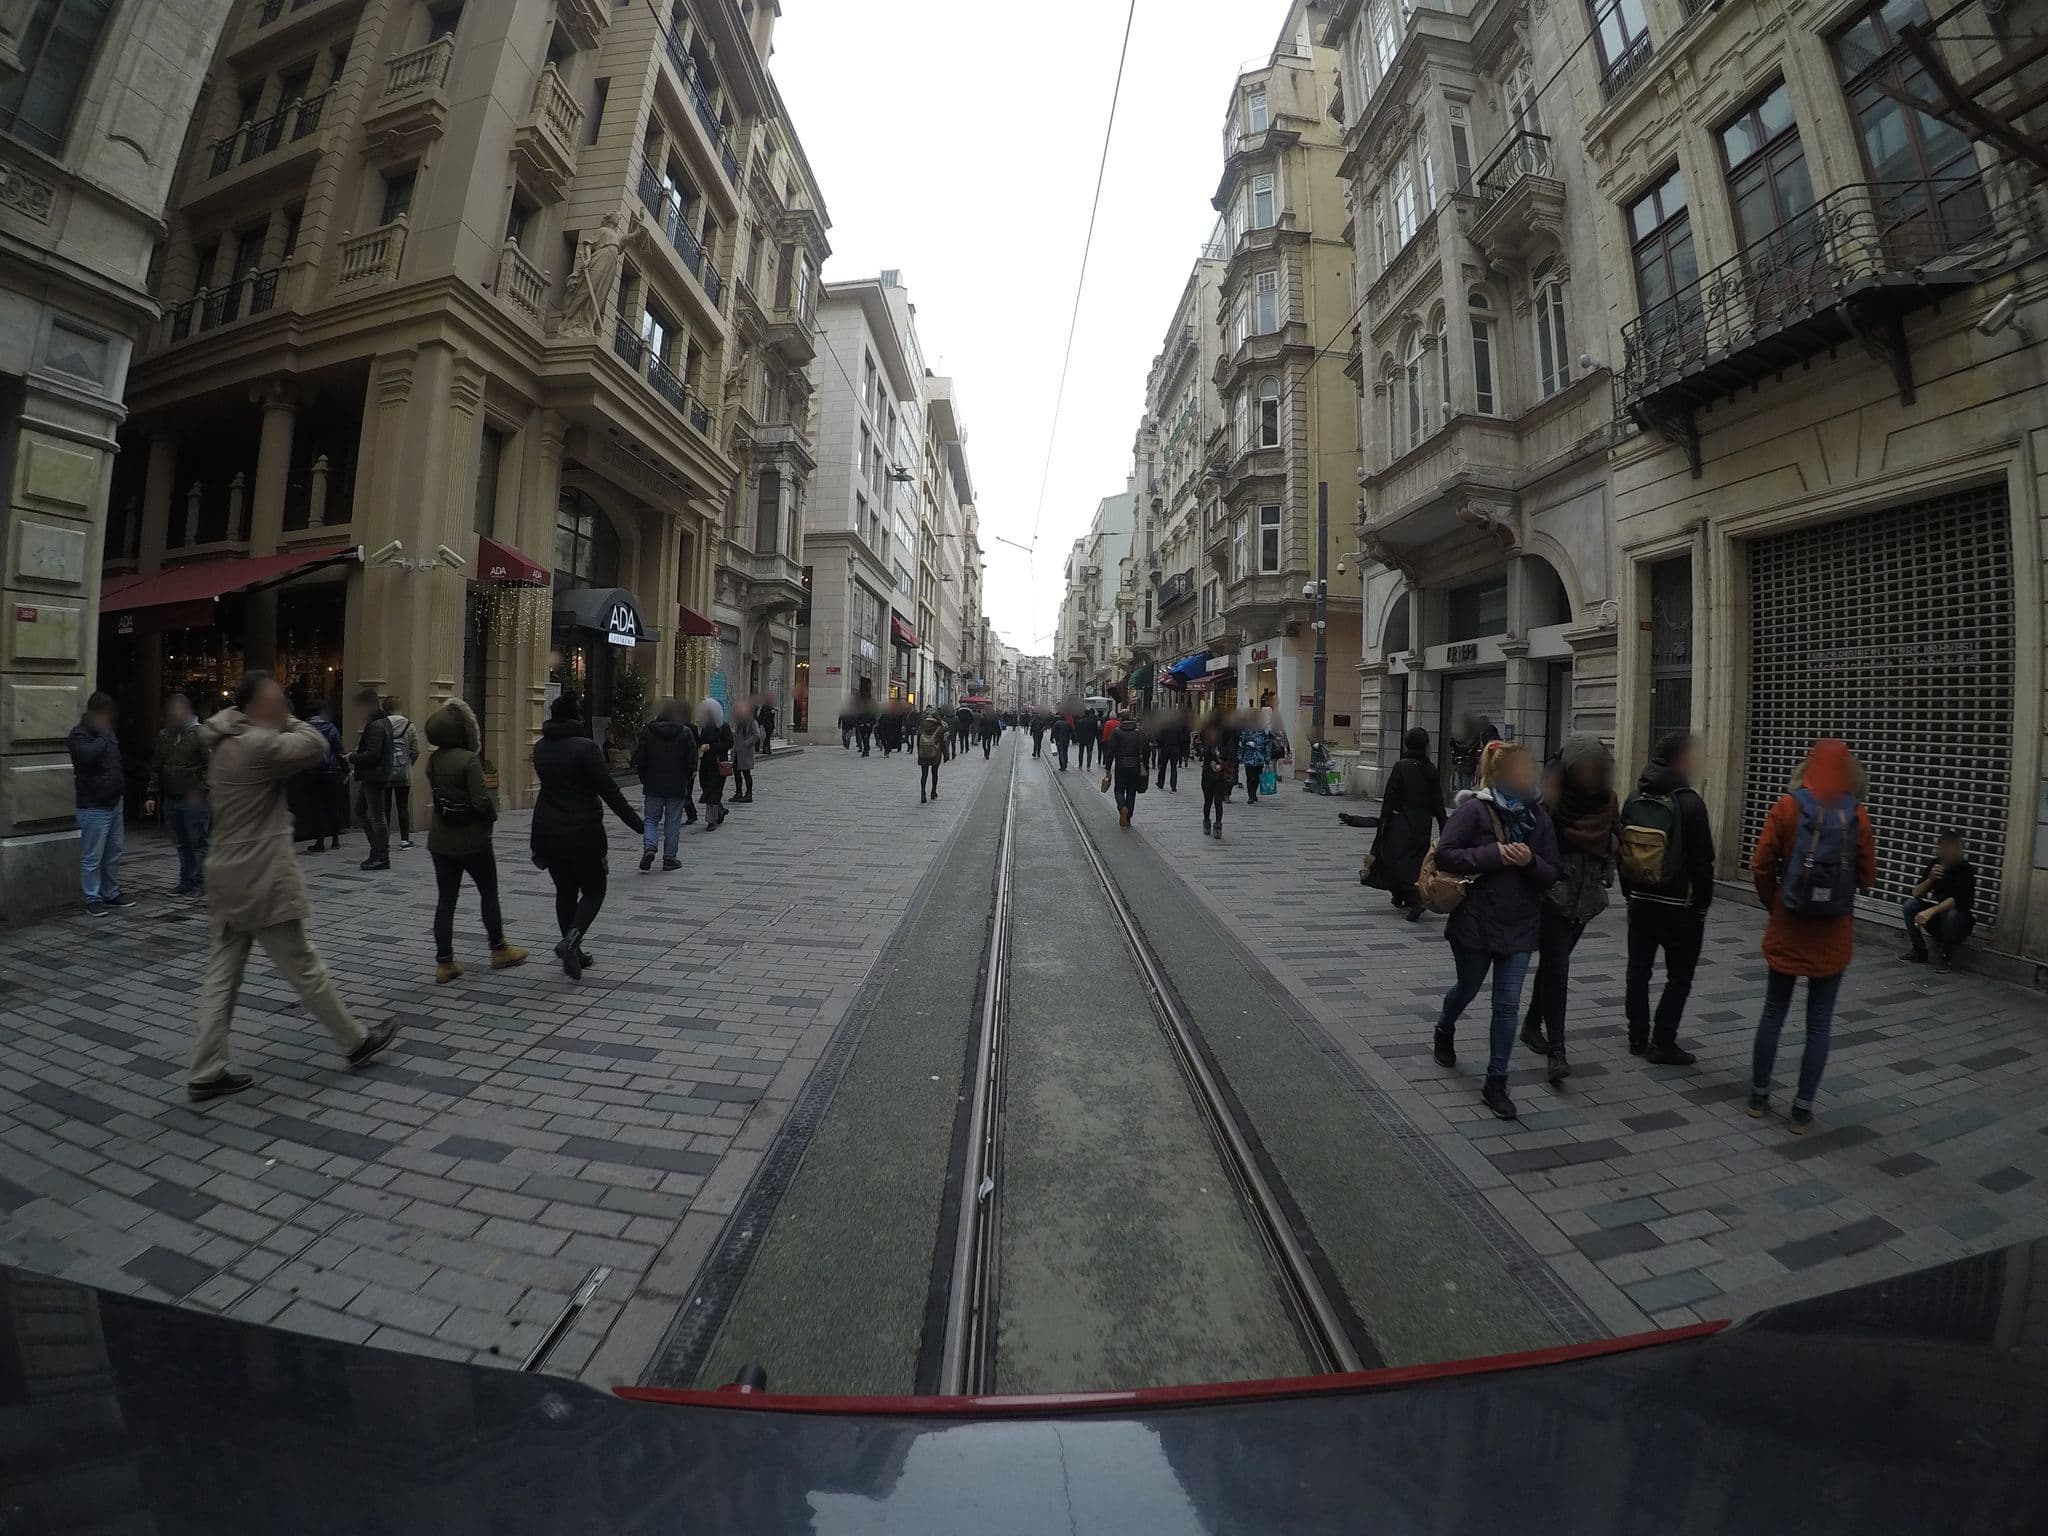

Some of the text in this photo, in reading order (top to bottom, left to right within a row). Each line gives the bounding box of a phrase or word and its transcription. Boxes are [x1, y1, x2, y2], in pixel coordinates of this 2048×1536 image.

[490, 566, 506, 575] ADA
[532, 570, 542, 579] ADA
[610, 605, 635, 635] ADA
